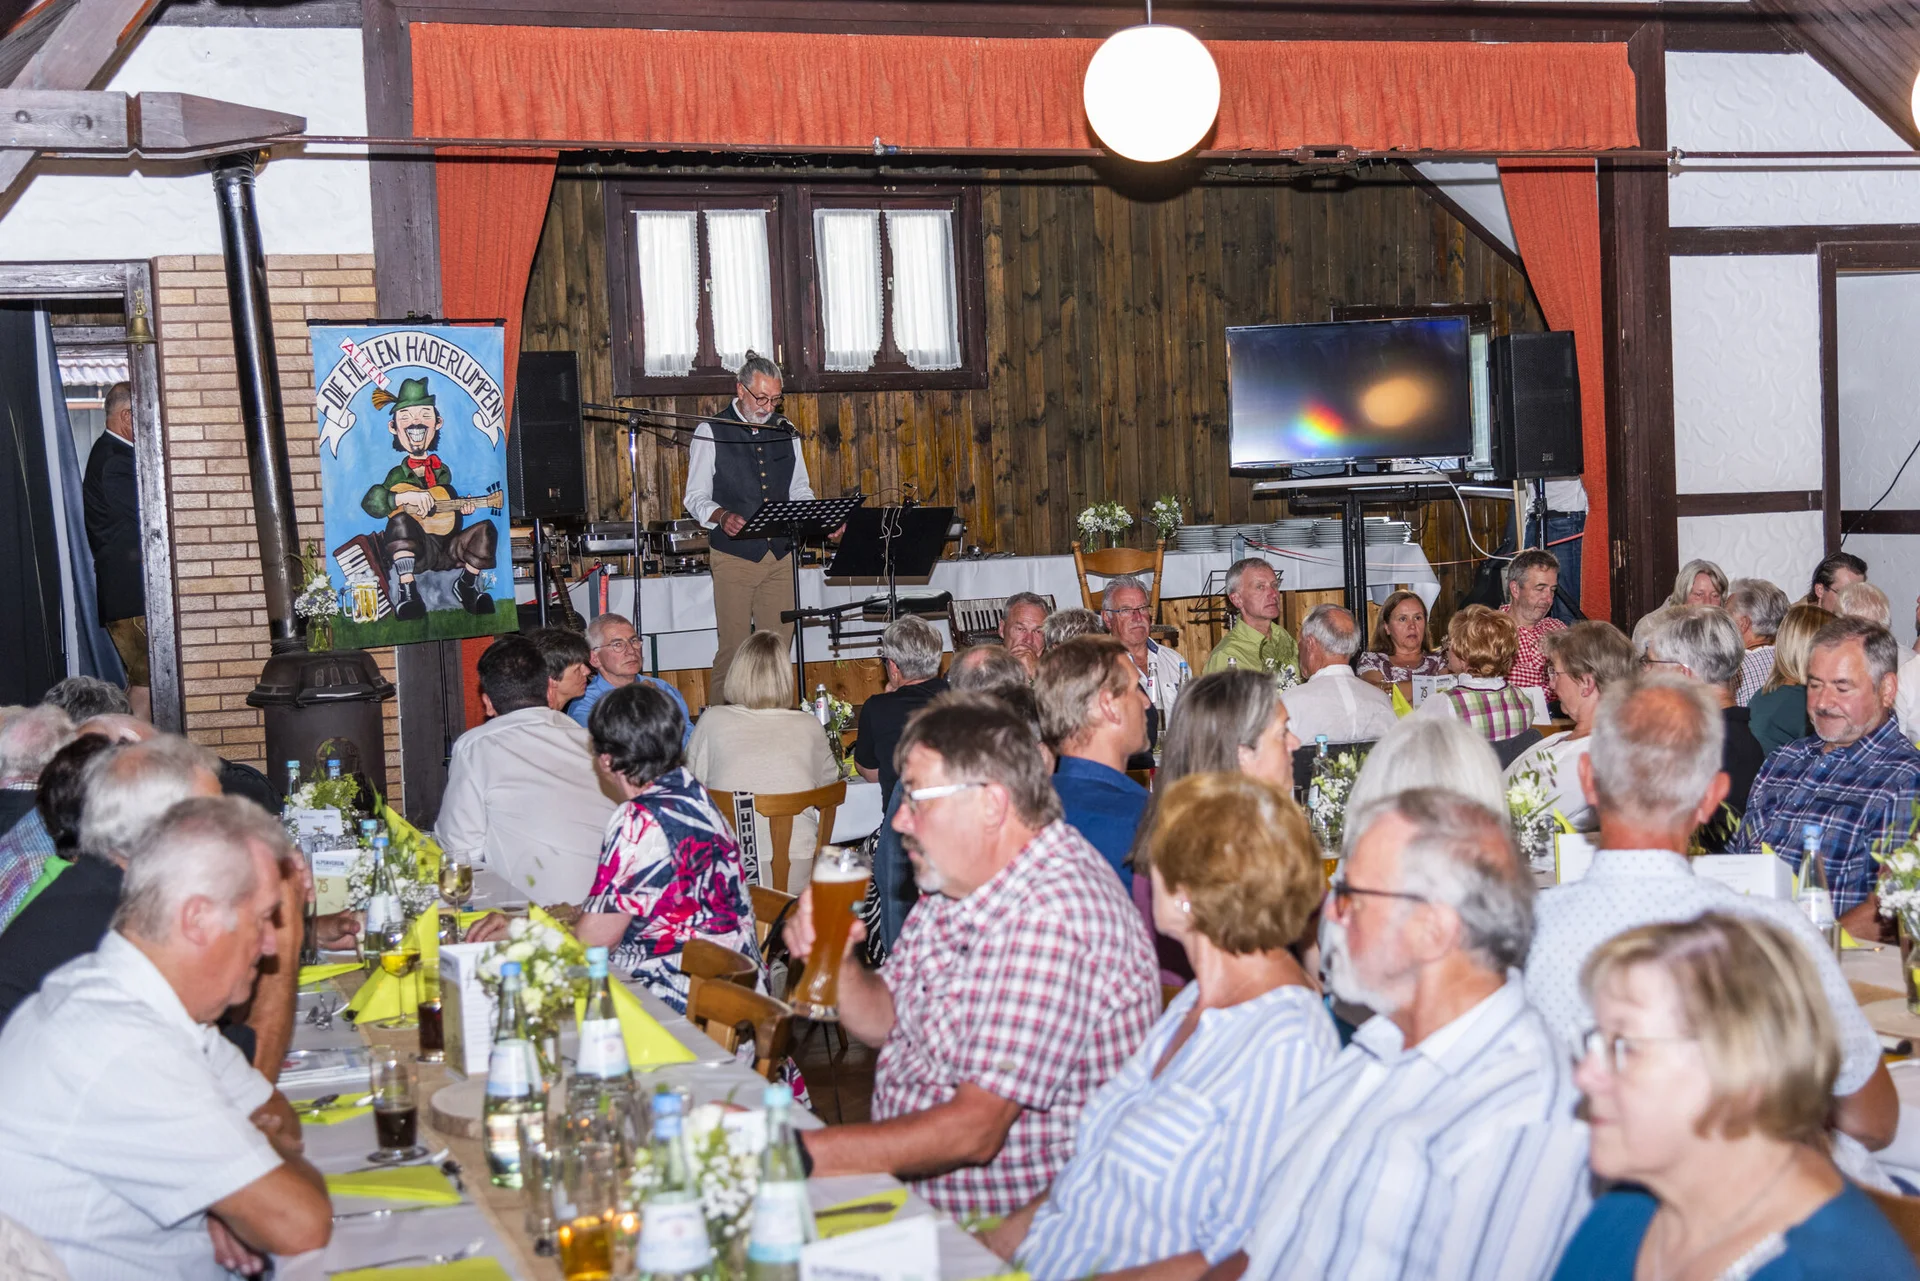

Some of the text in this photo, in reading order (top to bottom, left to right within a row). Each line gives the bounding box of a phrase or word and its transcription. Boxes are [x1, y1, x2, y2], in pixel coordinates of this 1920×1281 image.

[322, 376, 351, 410] DIE
[406, 336, 503, 418] HADERLUMPEN
[342, 343, 386, 385] ALTEN
[738, 799, 758, 887] LIEBESKIN
